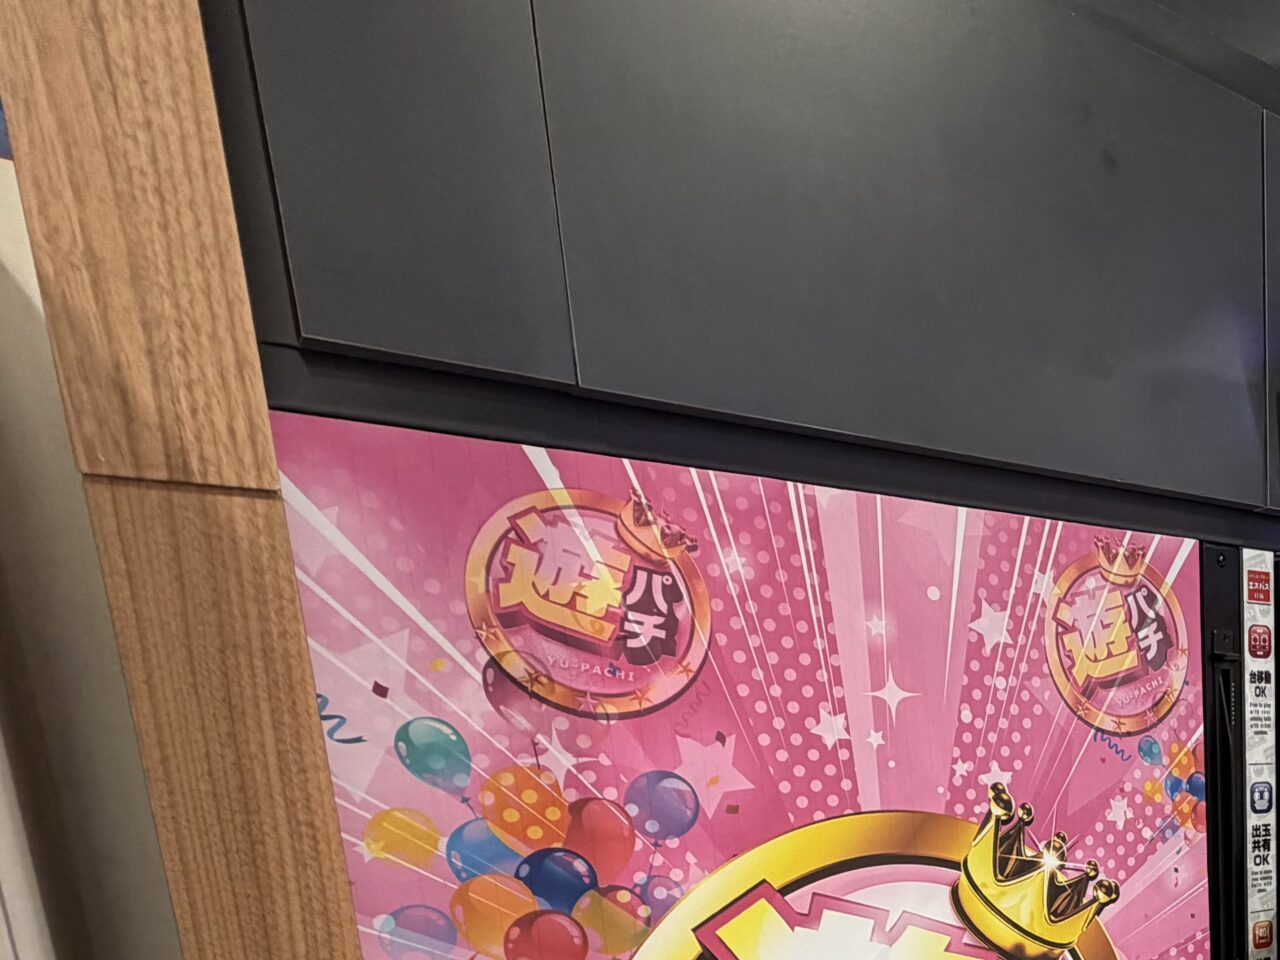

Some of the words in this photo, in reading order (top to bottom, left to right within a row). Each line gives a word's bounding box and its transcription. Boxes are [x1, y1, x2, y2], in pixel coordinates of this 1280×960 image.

[499, 511, 632, 642] 遊
[624, 568, 673, 648] パチ
[1056, 589, 1140, 688] 遊
[1126, 586, 1164, 661] パチ
[546, 655, 636, 682] YU-PACHI
[1249, 669, 1271, 685] 台移動
[1254, 685, 1267, 698] OK
[1251, 823, 1272, 839] 出玉
[1251, 838, 1272, 853] 共有
[1253, 853, 1270, 867] OK
